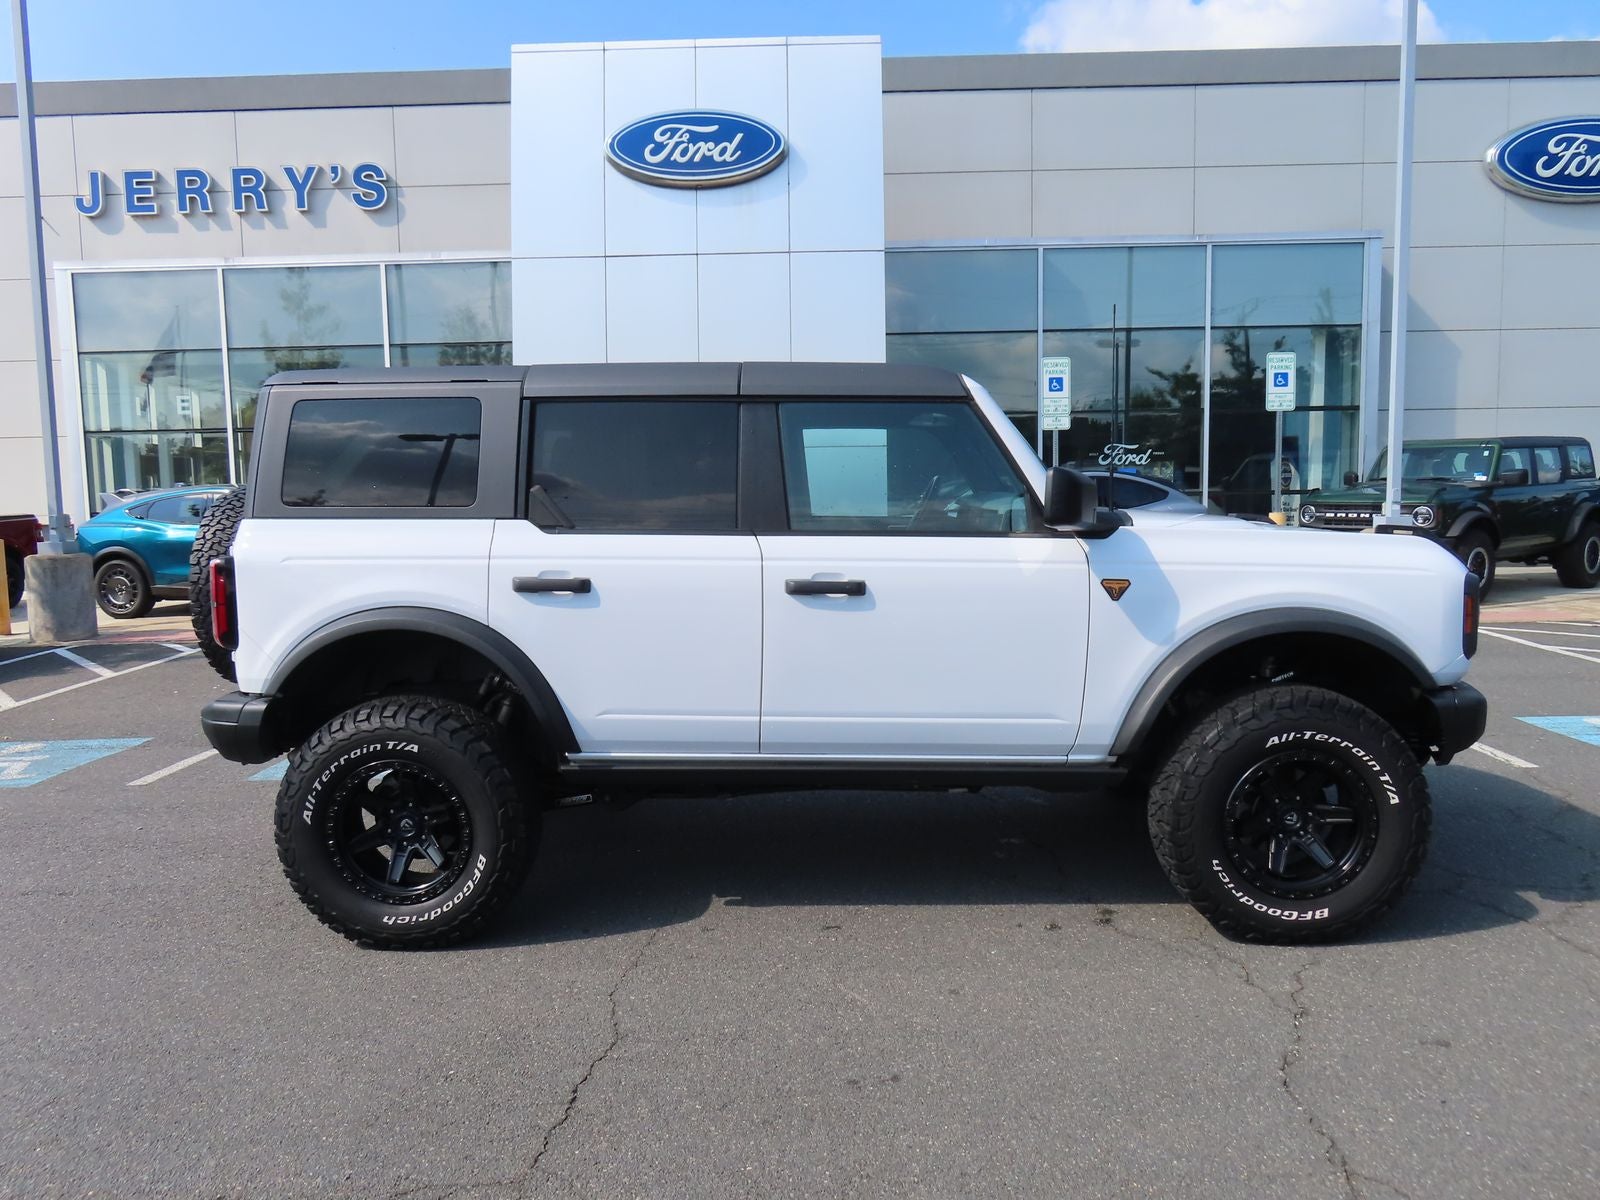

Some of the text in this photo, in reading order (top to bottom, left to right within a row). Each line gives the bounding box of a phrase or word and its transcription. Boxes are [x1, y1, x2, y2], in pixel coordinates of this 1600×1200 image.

[643, 123, 744, 164] Ford
[1535, 133, 1600, 178] Fo
[74, 162, 389, 217] JERRY'S
[1098, 443, 1153, 466] Ford
[1325, 511, 1381, 519] BRON
[302, 741, 419, 825] All-Terrain T/A
[1265, 730, 1400, 806] All-Terrain T/A
[382, 853, 487, 925] BFGoodrich
[1211, 858, 1330, 921] BFGoodrich
